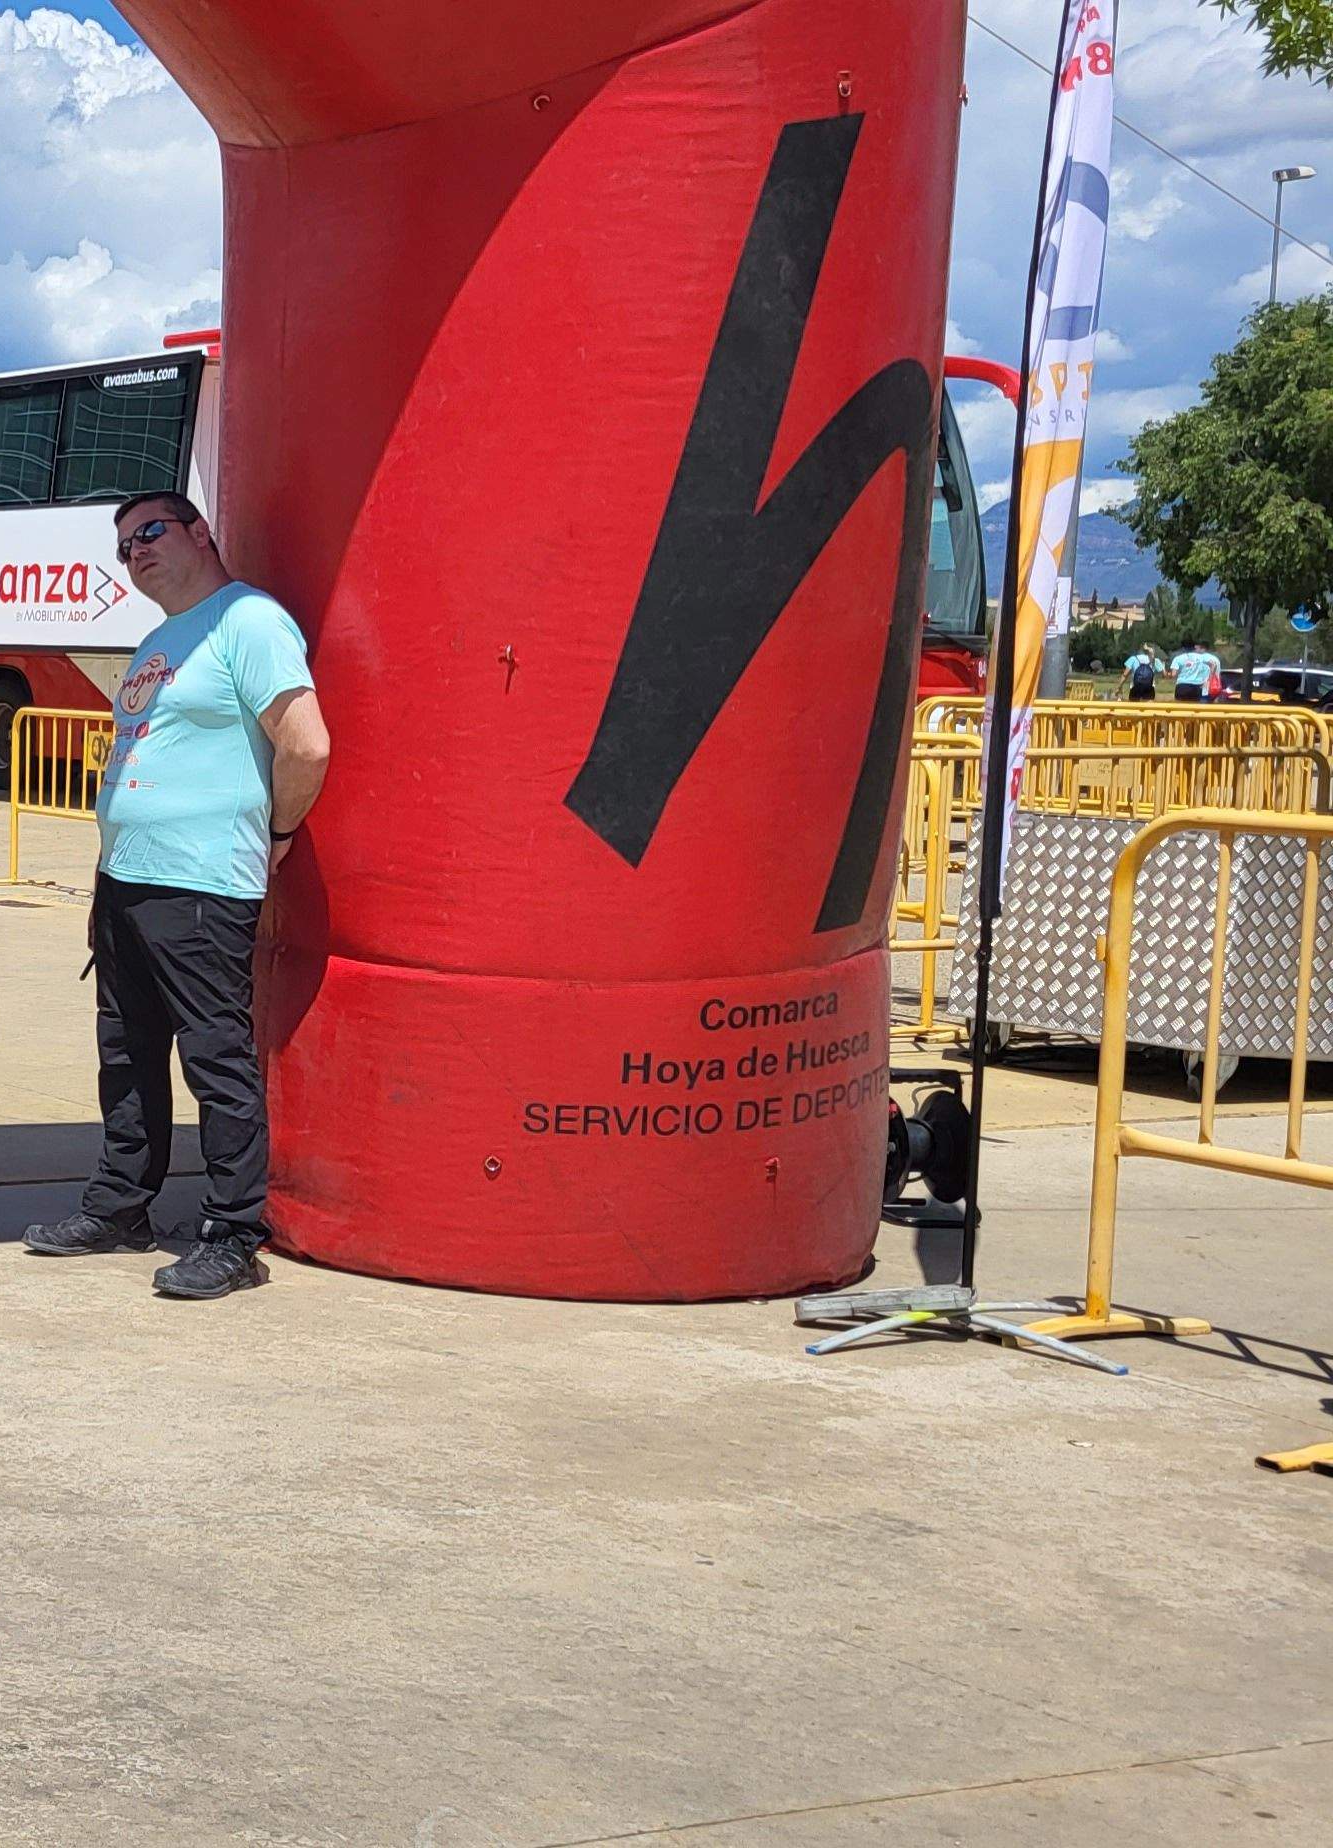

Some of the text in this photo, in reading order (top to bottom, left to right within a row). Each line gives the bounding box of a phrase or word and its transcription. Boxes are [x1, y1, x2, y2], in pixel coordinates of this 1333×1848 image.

[103, 366, 178, 388] avanzabus.com
[24, 609, 67, 622] MOBILITY
[68, 611, 87, 622] ADO
[699, 992, 839, 1031] Comarca
[620, 1031, 870, 1090] Hoya de Huesca
[523, 1102, 724, 1137] SERVICIO
[735, 1097, 783, 1131] DE
